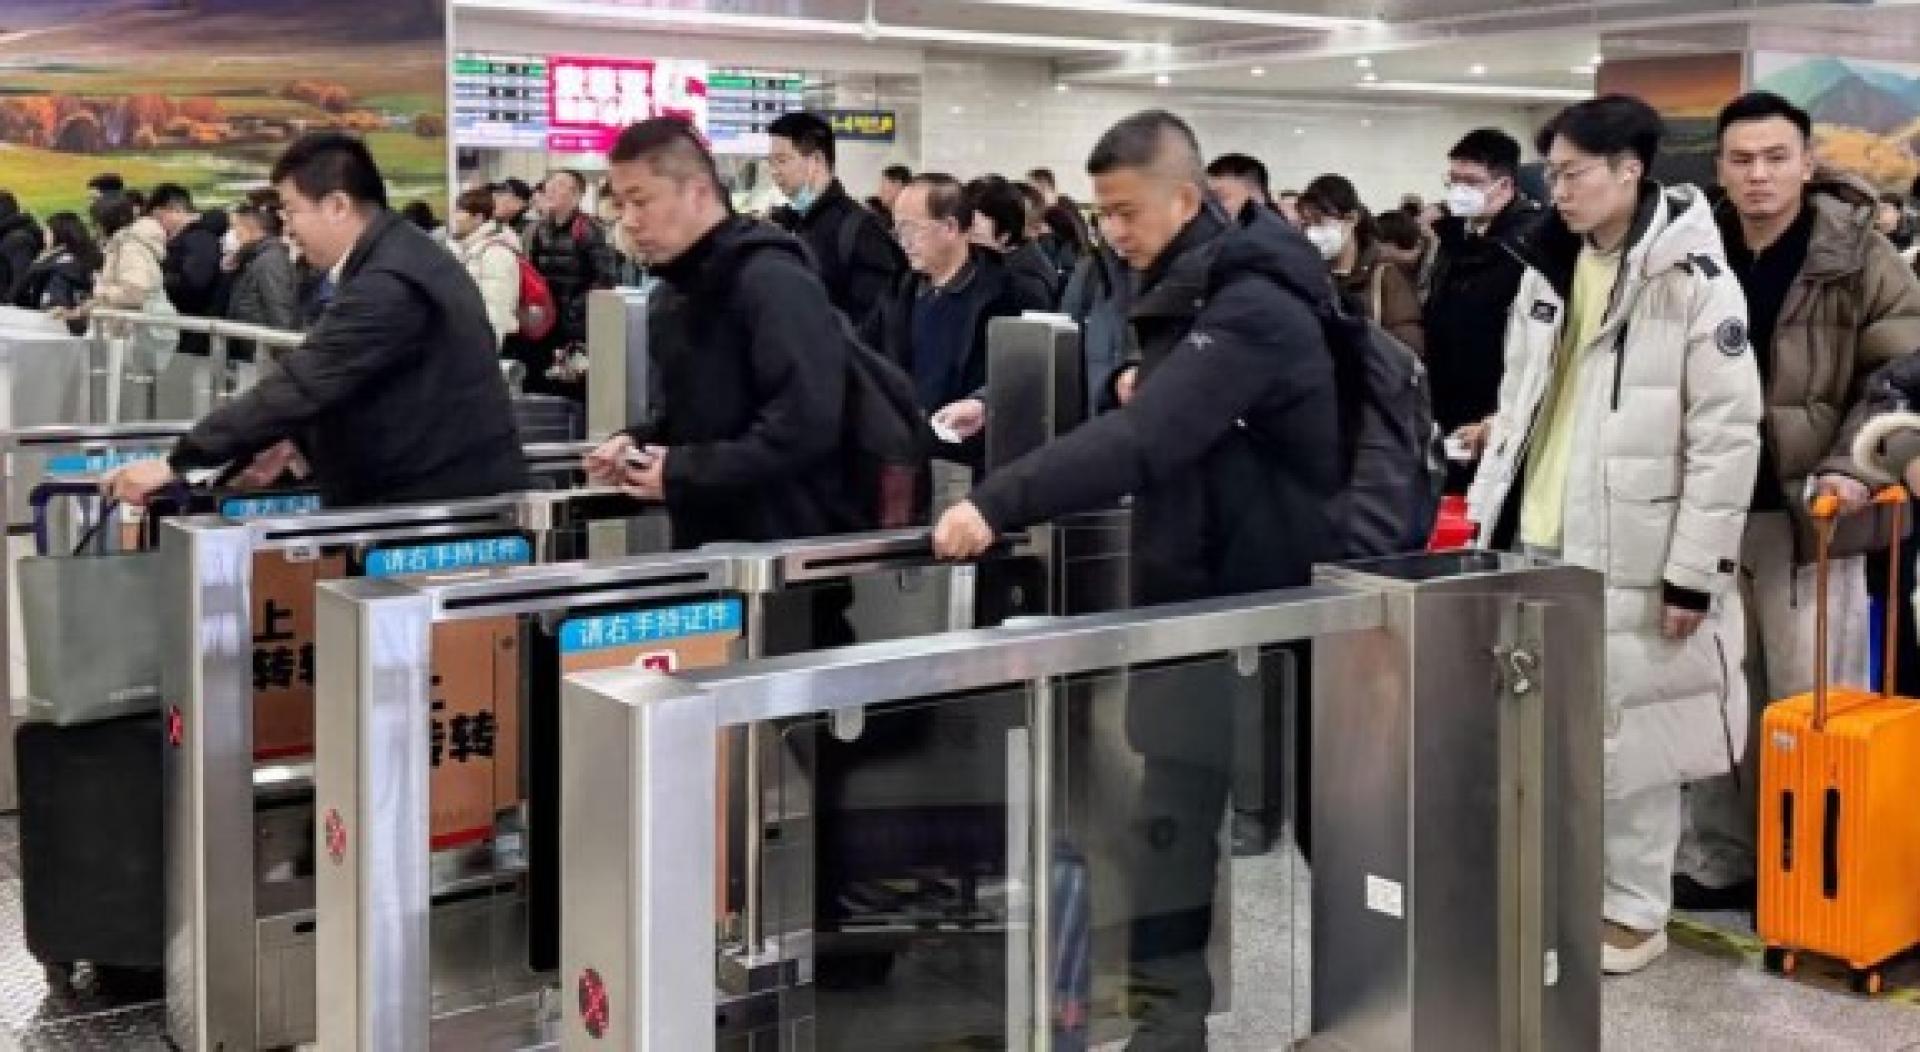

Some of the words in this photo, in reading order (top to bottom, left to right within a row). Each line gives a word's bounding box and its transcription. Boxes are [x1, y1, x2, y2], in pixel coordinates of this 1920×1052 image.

[384, 537, 519, 573] 请右手持证件
[253, 599, 295, 643] 上
[578, 602, 728, 648] 请右手持证件
